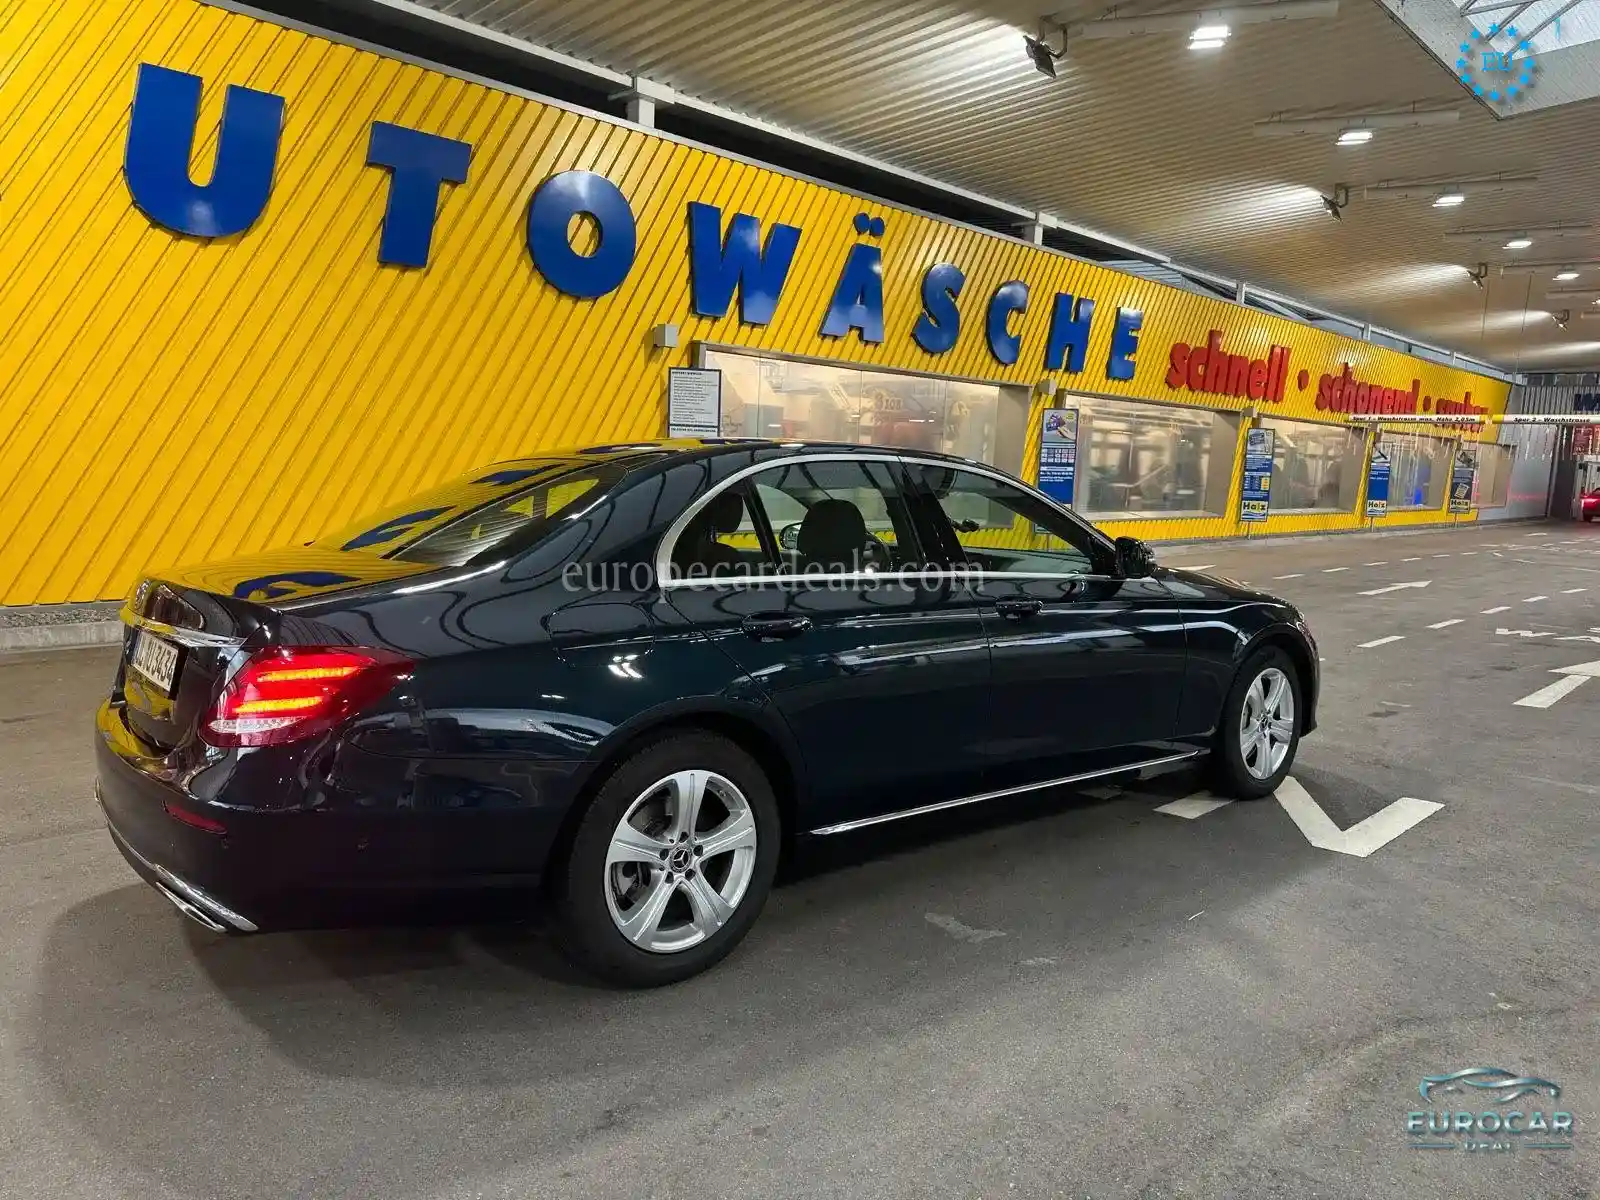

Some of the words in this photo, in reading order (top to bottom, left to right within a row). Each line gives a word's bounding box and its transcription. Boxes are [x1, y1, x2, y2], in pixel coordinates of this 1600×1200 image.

[123, 63, 1144, 381] UTOWÄSCHE
[1165, 329, 1292, 404] schnell
[1315, 361, 1421, 415] schonend
